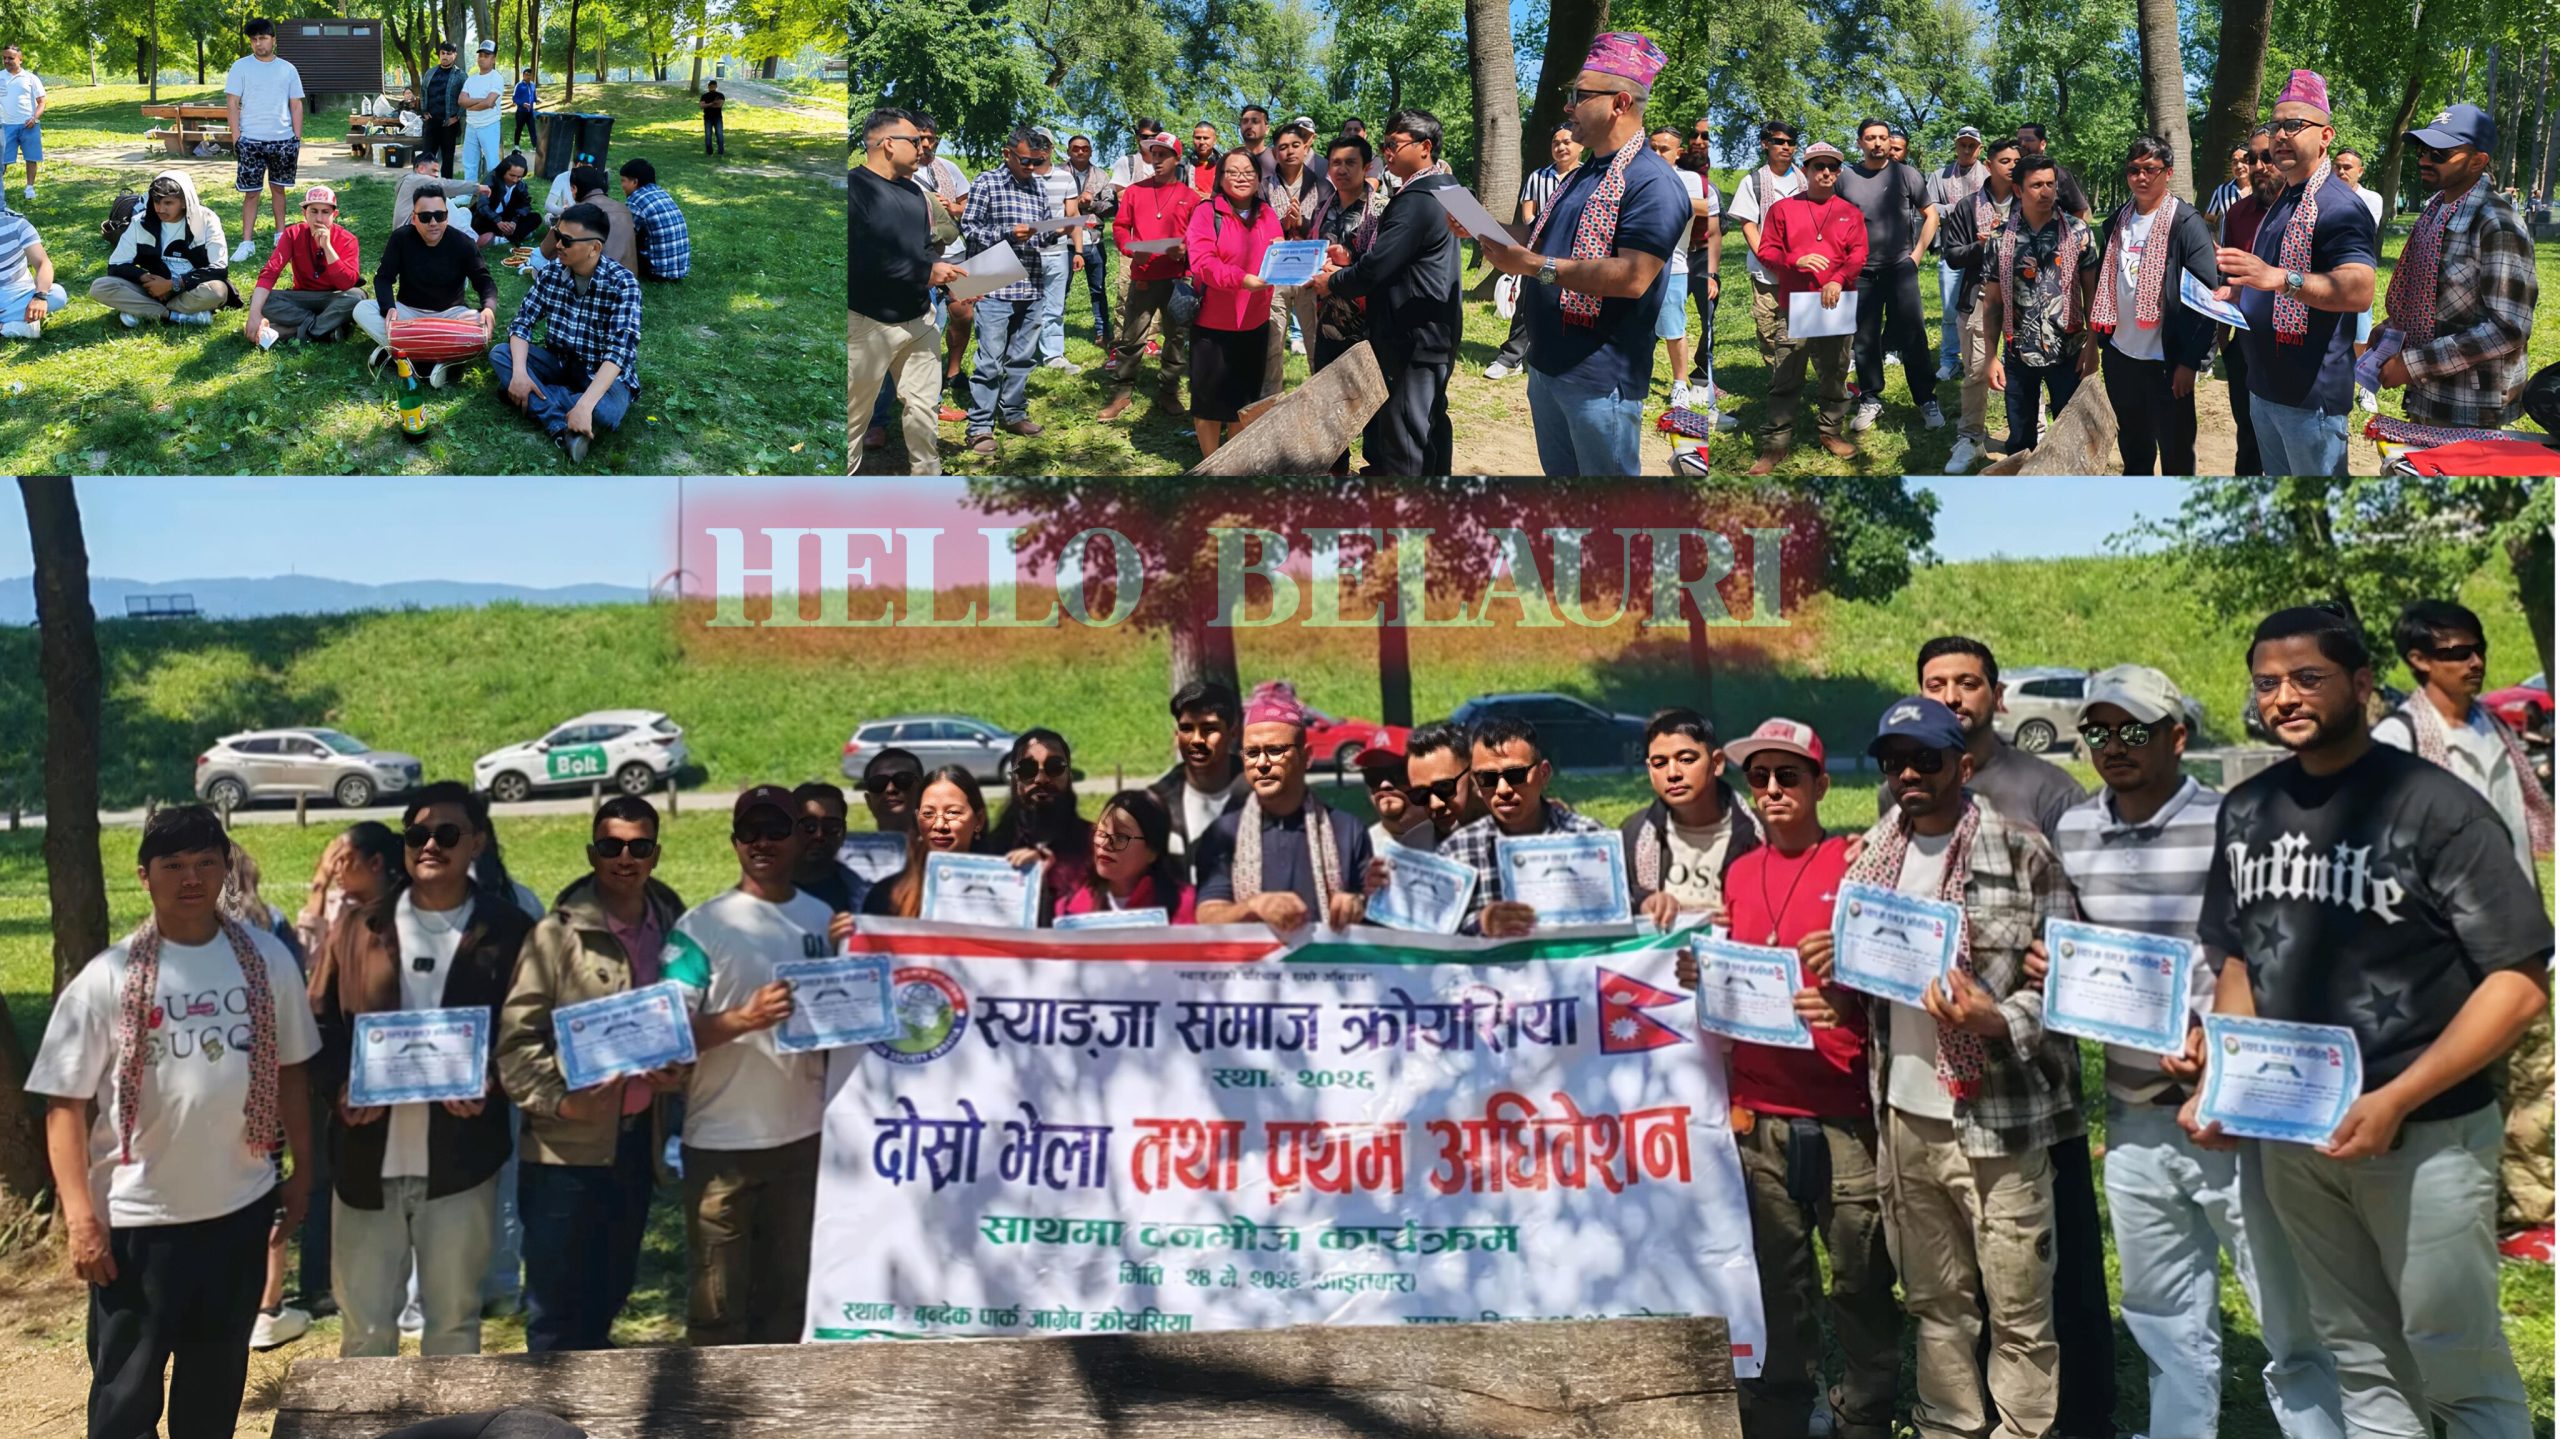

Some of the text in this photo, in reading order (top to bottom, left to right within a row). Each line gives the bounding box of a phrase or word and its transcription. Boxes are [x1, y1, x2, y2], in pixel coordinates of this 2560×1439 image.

[557, 755, 598, 774] Bolt
[975, 985, 1580, 1058] स्याङ्जा समाज क्रोयसिया
[1297, 1068, 1376, 1091] २०२६
[872, 1091, 1692, 1204] दोस्रो भेला तथा प्रथम अधिवेशन
[980, 1214, 1127, 1248] साथमा
[1317, 1218, 1520, 1255] कार्यक्रम
[1118, 1259, 1164, 1286] मिति
[842, 1302, 896, 1321] स्थान
[979, 1303, 1022, 1327] पार्क
